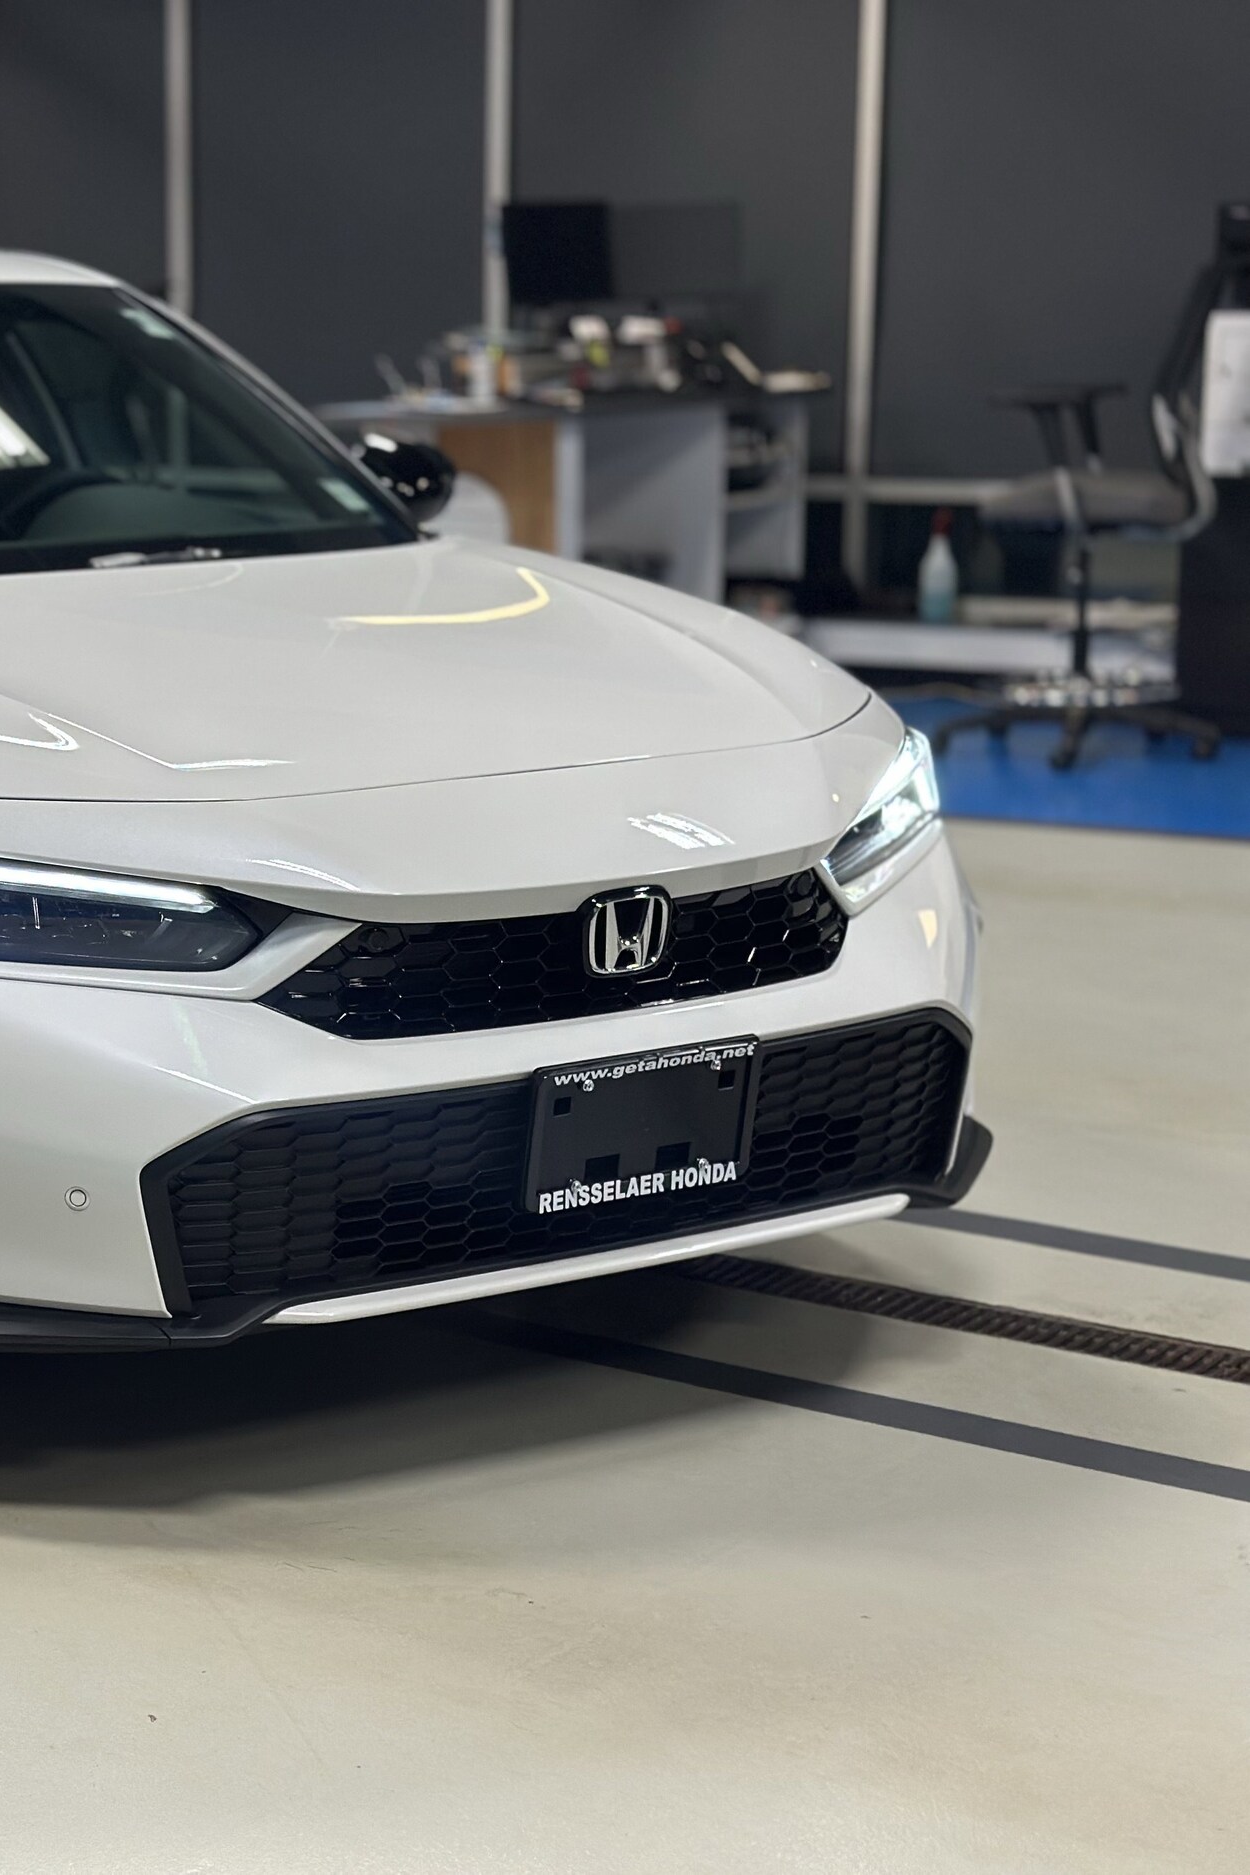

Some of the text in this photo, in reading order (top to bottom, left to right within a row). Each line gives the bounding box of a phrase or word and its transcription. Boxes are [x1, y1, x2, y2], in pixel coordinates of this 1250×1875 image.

[554, 1044, 754, 1086] www.getahonda.net
[539, 1161, 736, 1214] RENSSELAER HONDA
